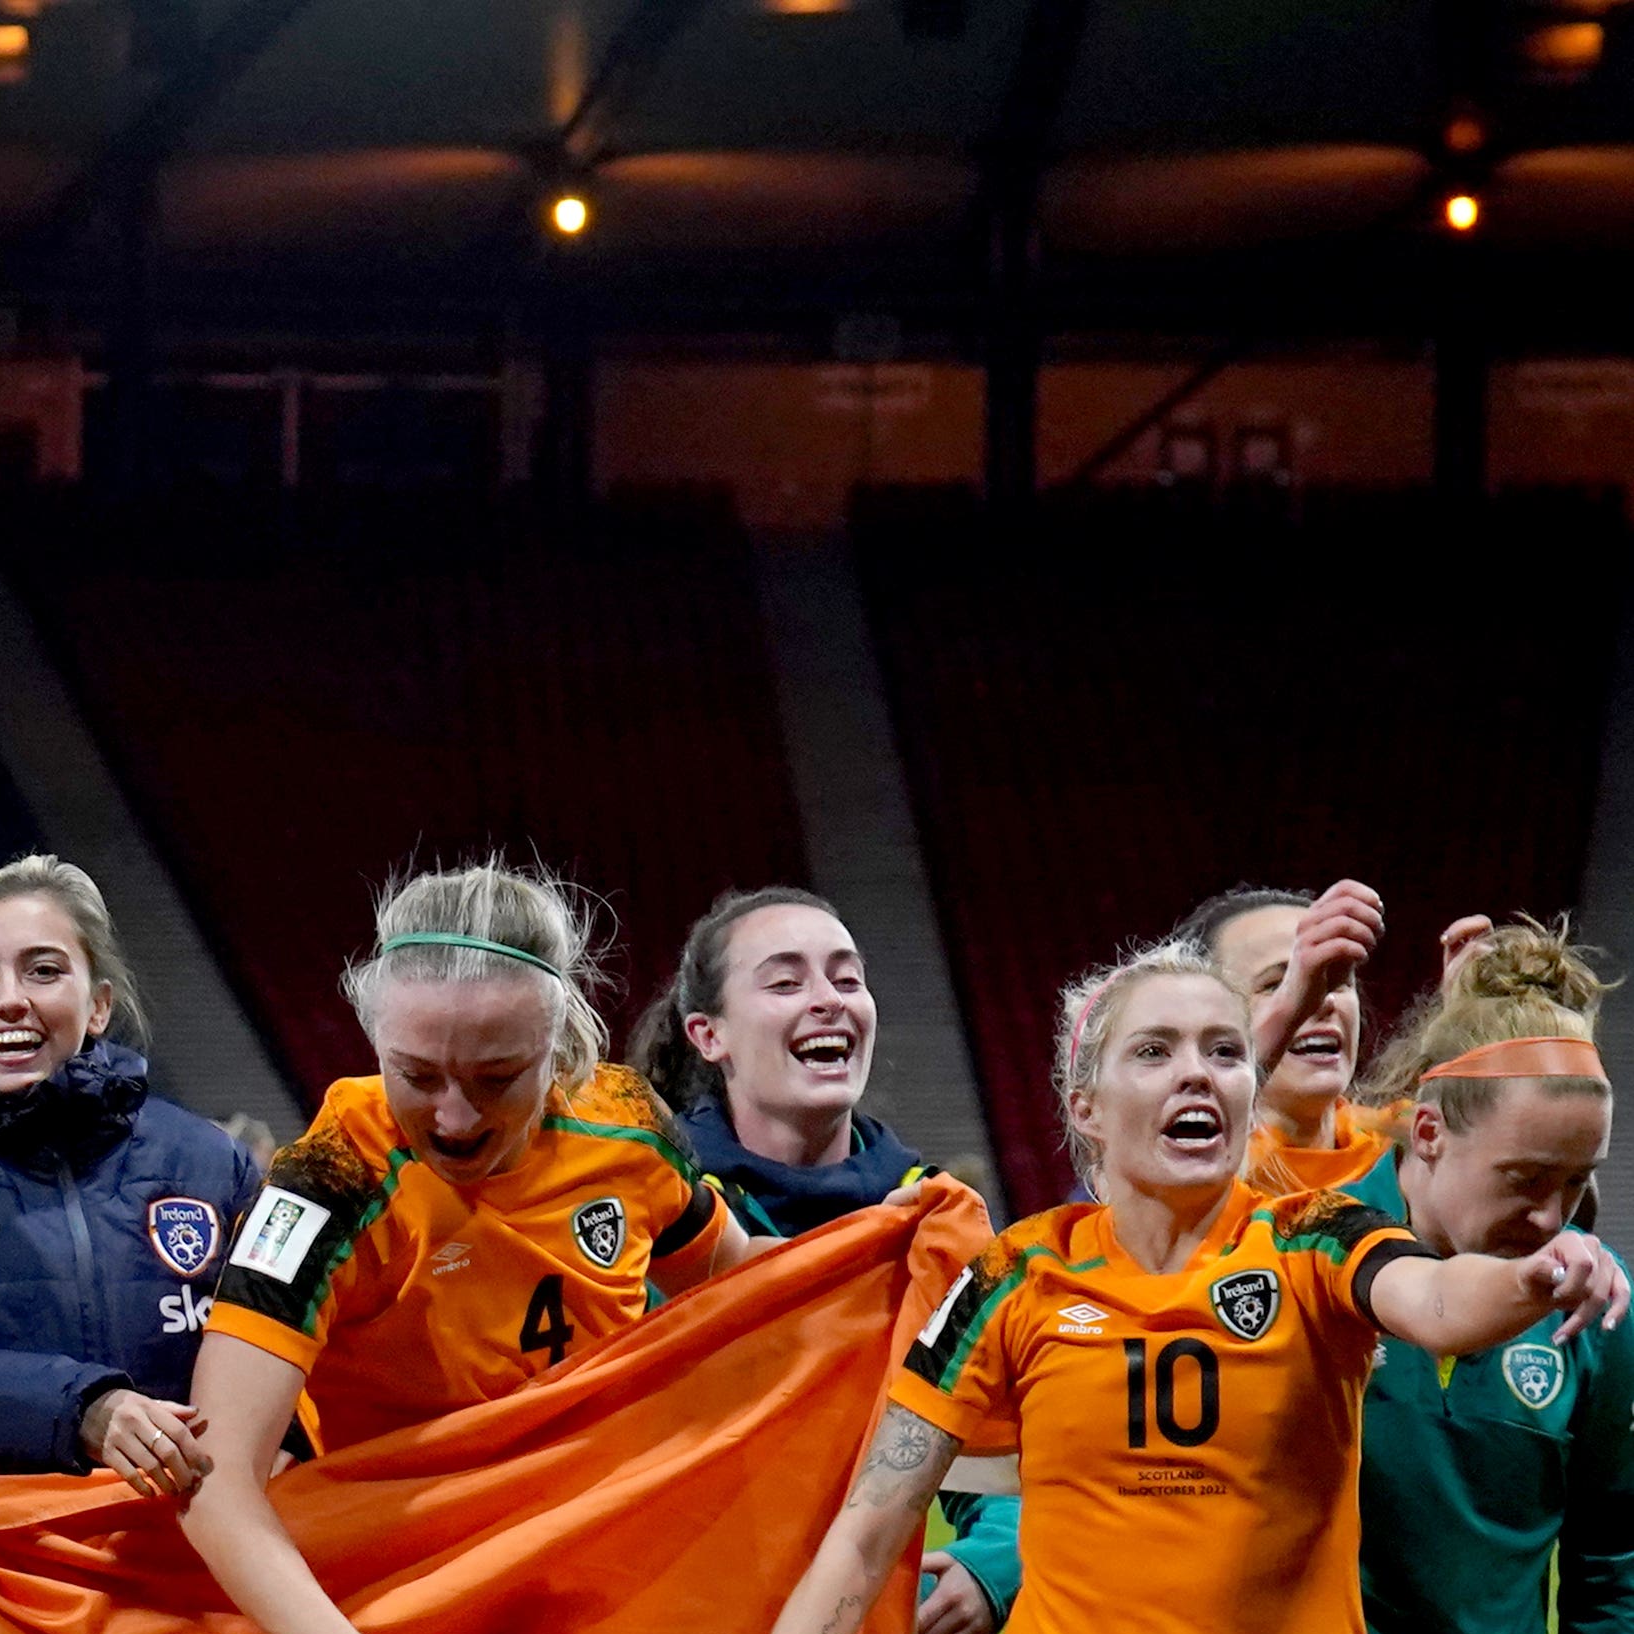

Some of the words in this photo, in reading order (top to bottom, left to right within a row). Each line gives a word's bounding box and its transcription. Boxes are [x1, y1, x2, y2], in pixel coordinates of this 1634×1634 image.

[160, 1206, 204, 1222] Ireland
[581, 1206, 614, 1228] Ireland
[432, 1258, 471, 1275] umbro
[1221, 1278, 1265, 1299] Ireland
[159, 1284, 213, 1333] sk
[519, 1274, 575, 1366] 4
[1058, 1324, 1103, 1335] umbro
[1514, 1352, 1553, 1366] Ireland
[1122, 1337, 1220, 1448] 10
[1138, 1471, 1205, 1481] SCOTLAND
